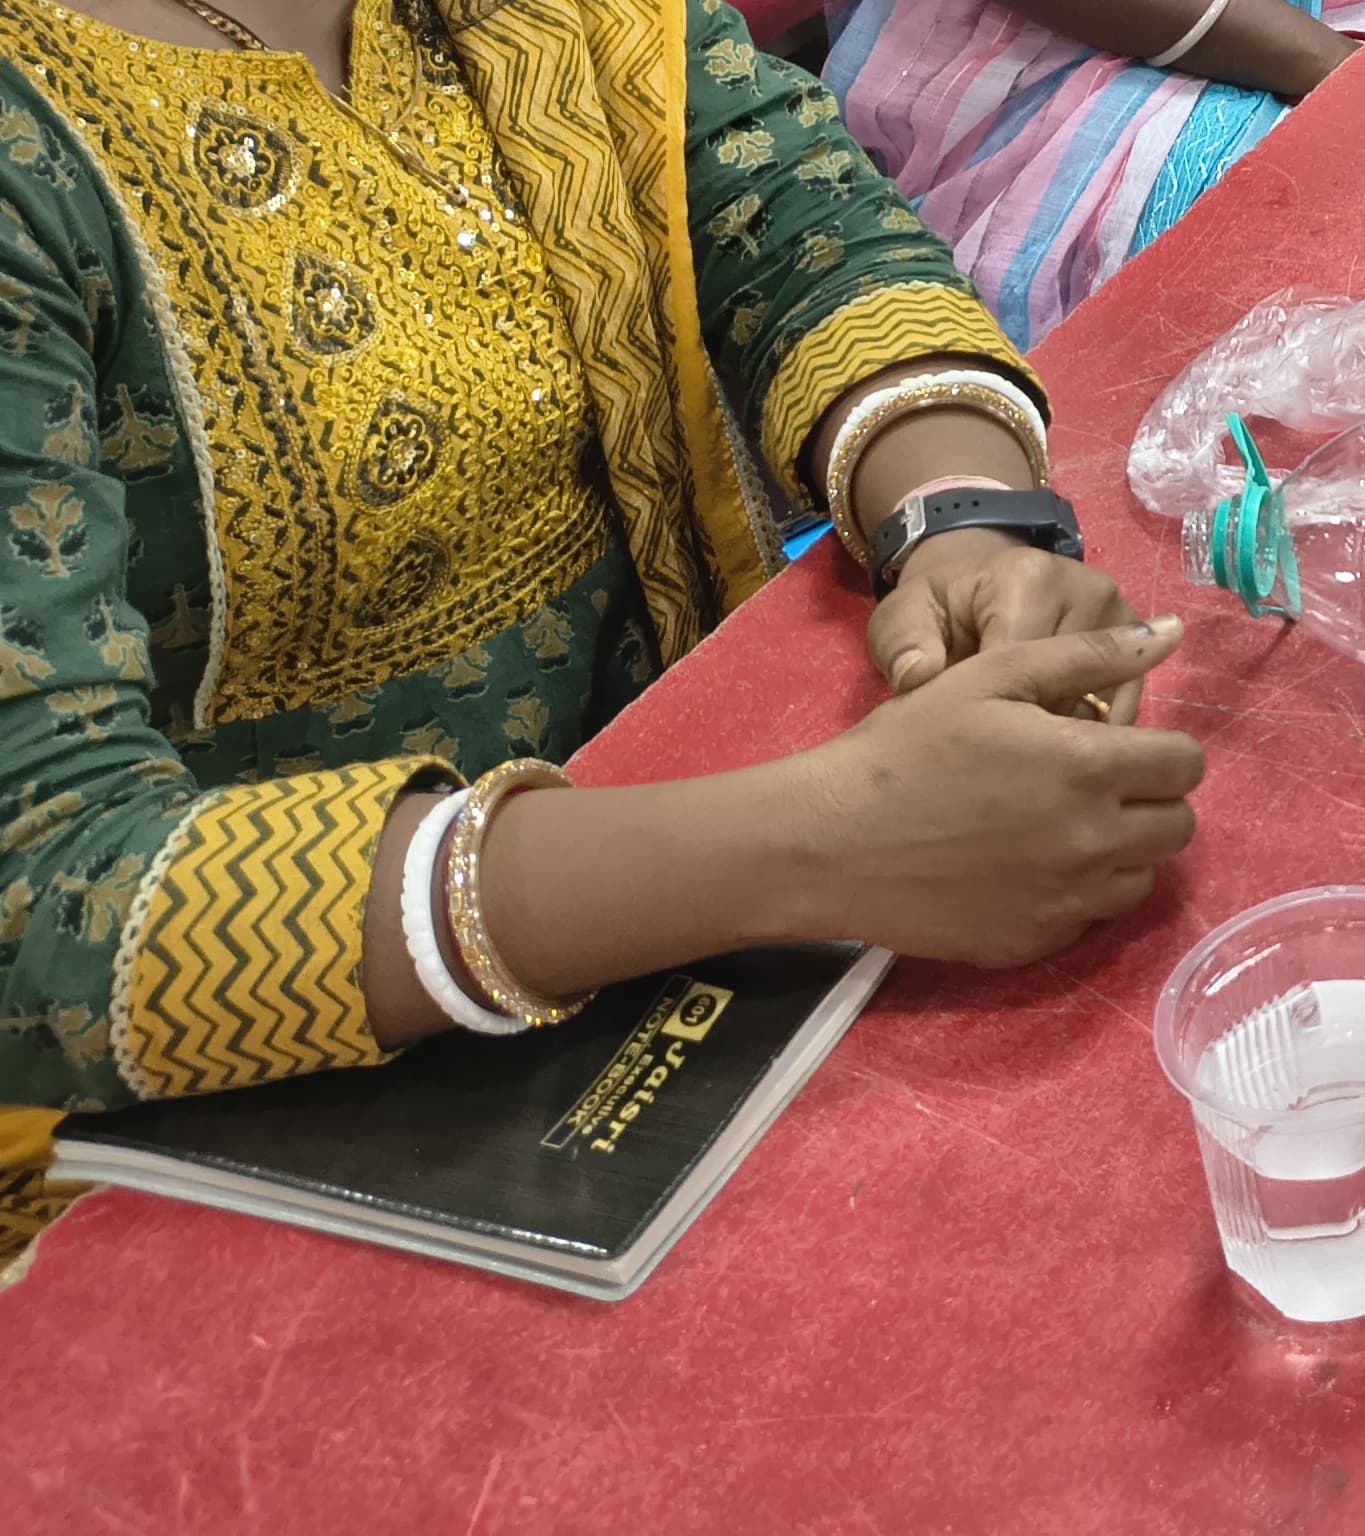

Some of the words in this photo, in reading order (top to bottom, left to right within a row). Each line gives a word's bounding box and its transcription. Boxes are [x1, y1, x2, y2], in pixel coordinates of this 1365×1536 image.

[566, 996, 675, 1125] NOTE-BOOK
[581, 1053, 654, 1135] Executive
[590, 1040, 686, 1154] Jaisri
